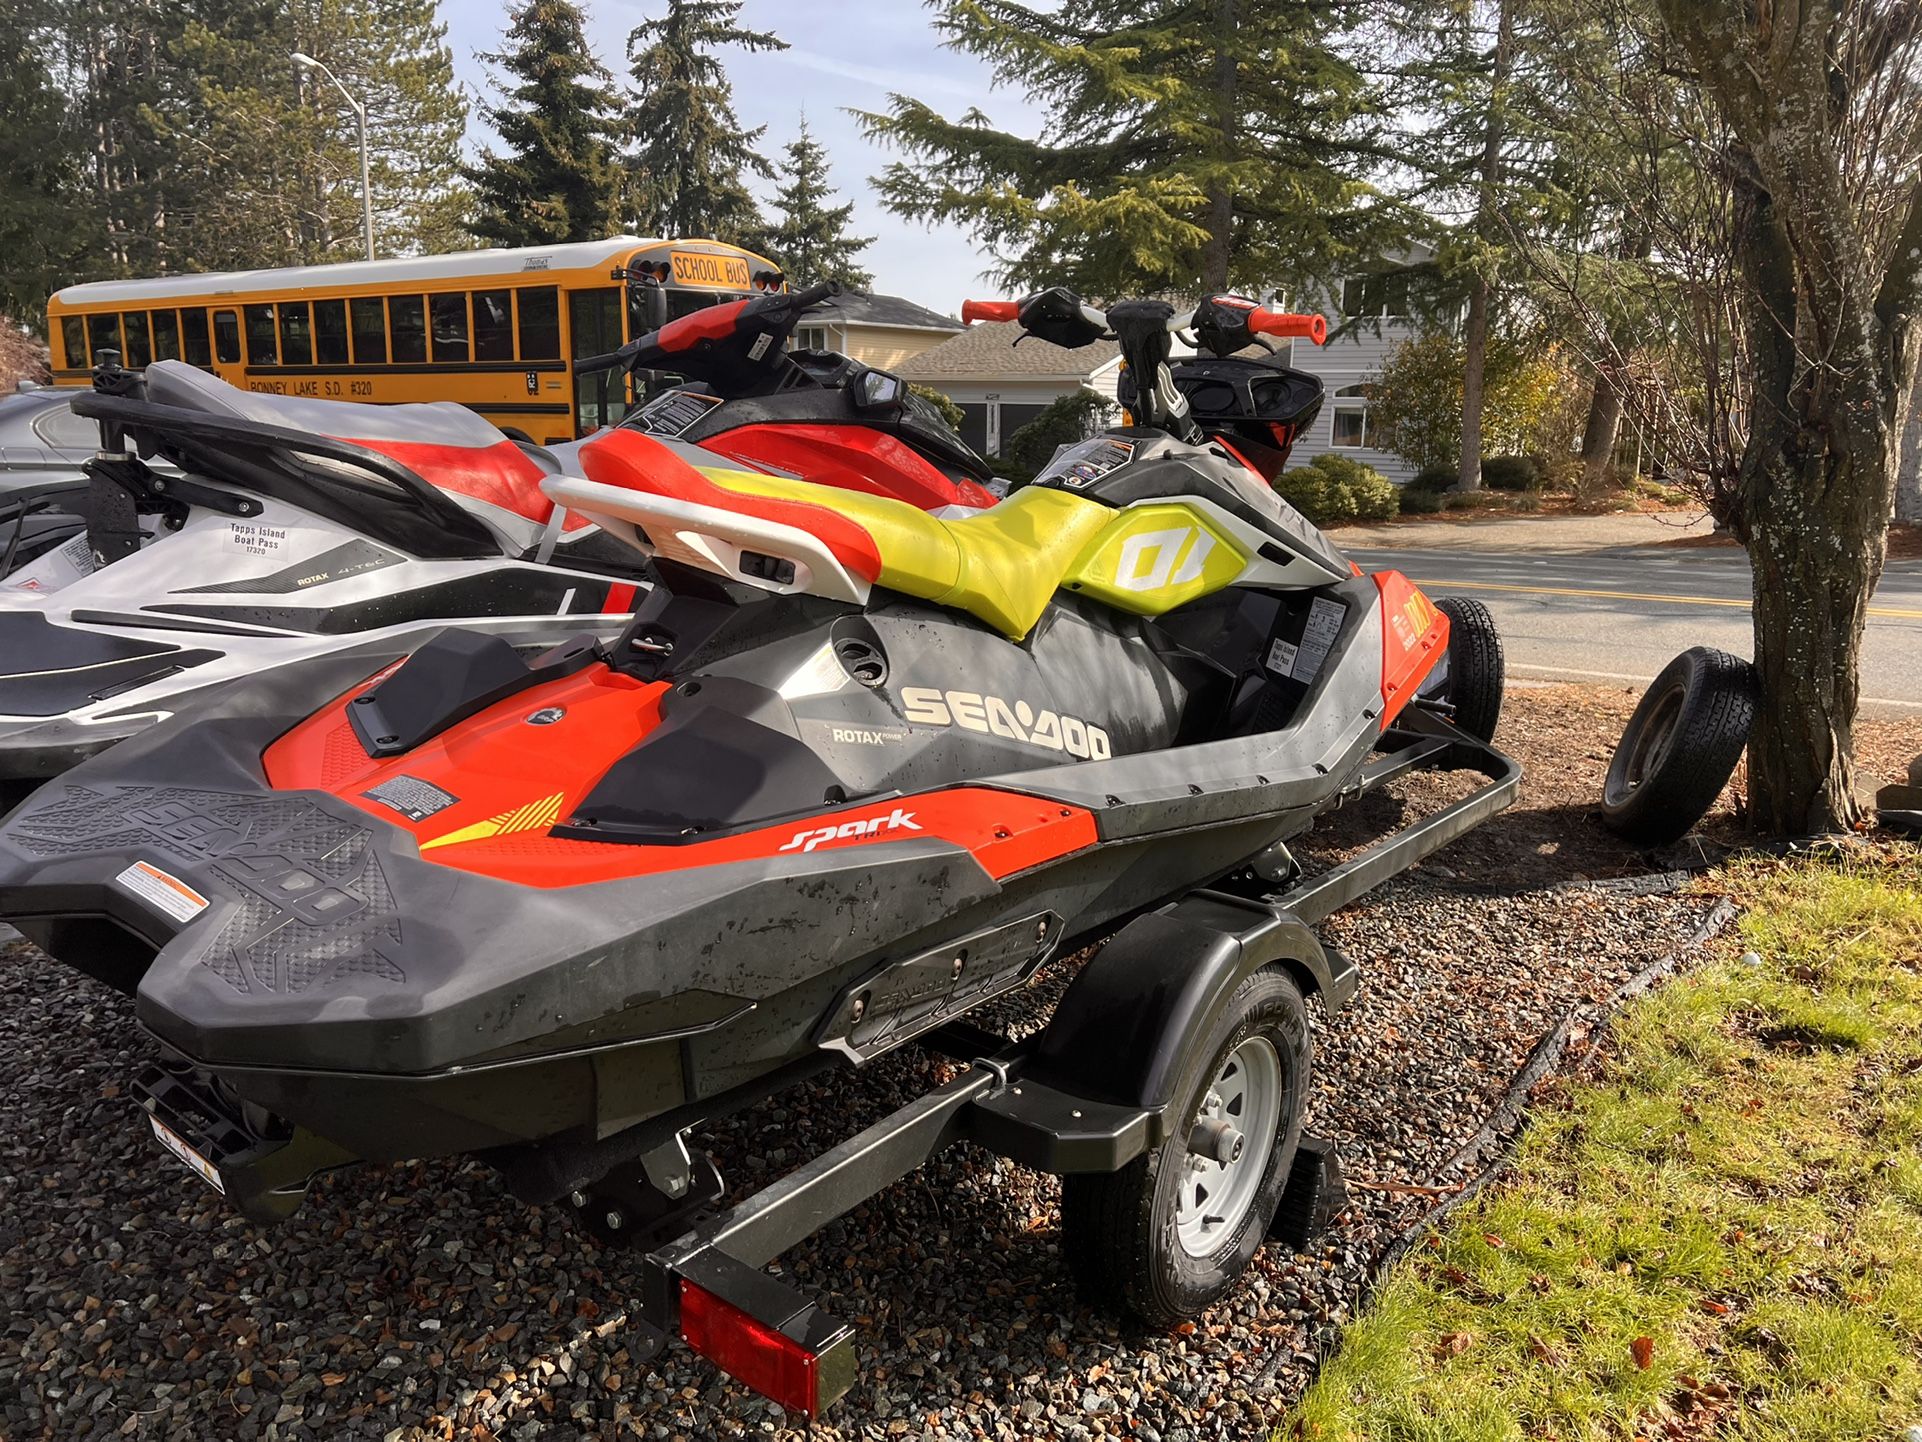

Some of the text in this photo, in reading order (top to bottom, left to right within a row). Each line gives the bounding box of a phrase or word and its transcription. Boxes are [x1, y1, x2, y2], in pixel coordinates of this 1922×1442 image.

[674, 256, 748, 285] SCHOOL BUS
[293, 381, 319, 396] LAKE
[325, 381, 344, 396] S.D.
[350, 381, 372, 396] #320
[230, 522, 286, 539] Tapps Island
[234, 534, 279, 550] Boat Pass
[296, 572, 330, 586] ROTAX
[832, 728, 884, 745] ROTAX
